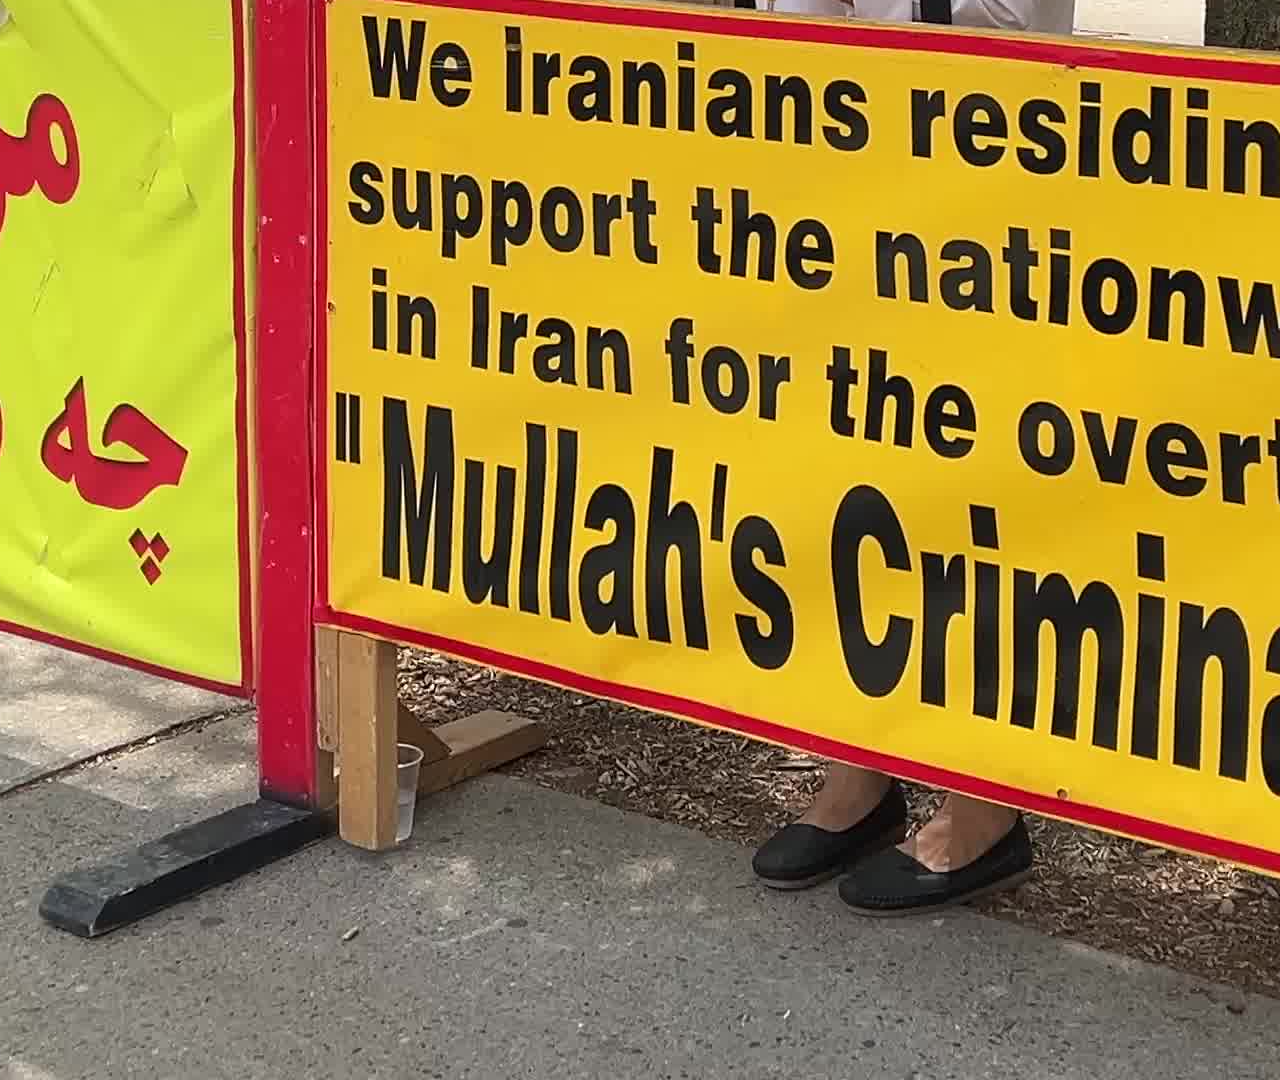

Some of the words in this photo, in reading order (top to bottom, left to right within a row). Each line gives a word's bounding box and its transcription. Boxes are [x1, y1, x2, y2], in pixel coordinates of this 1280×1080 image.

[361, 15, 473, 108] We
[504, 25, 869, 152] iranians
[348, 161, 658, 266] support
[691, 187, 834, 290] the
[372, 268, 437, 360] in
[471, 285, 632, 395] Iran
[664, 317, 791, 421] for
[826, 345, 977, 459] the
[40, 376, 189, 585] چه
[335, 391, 794, 670] "Mullah's
